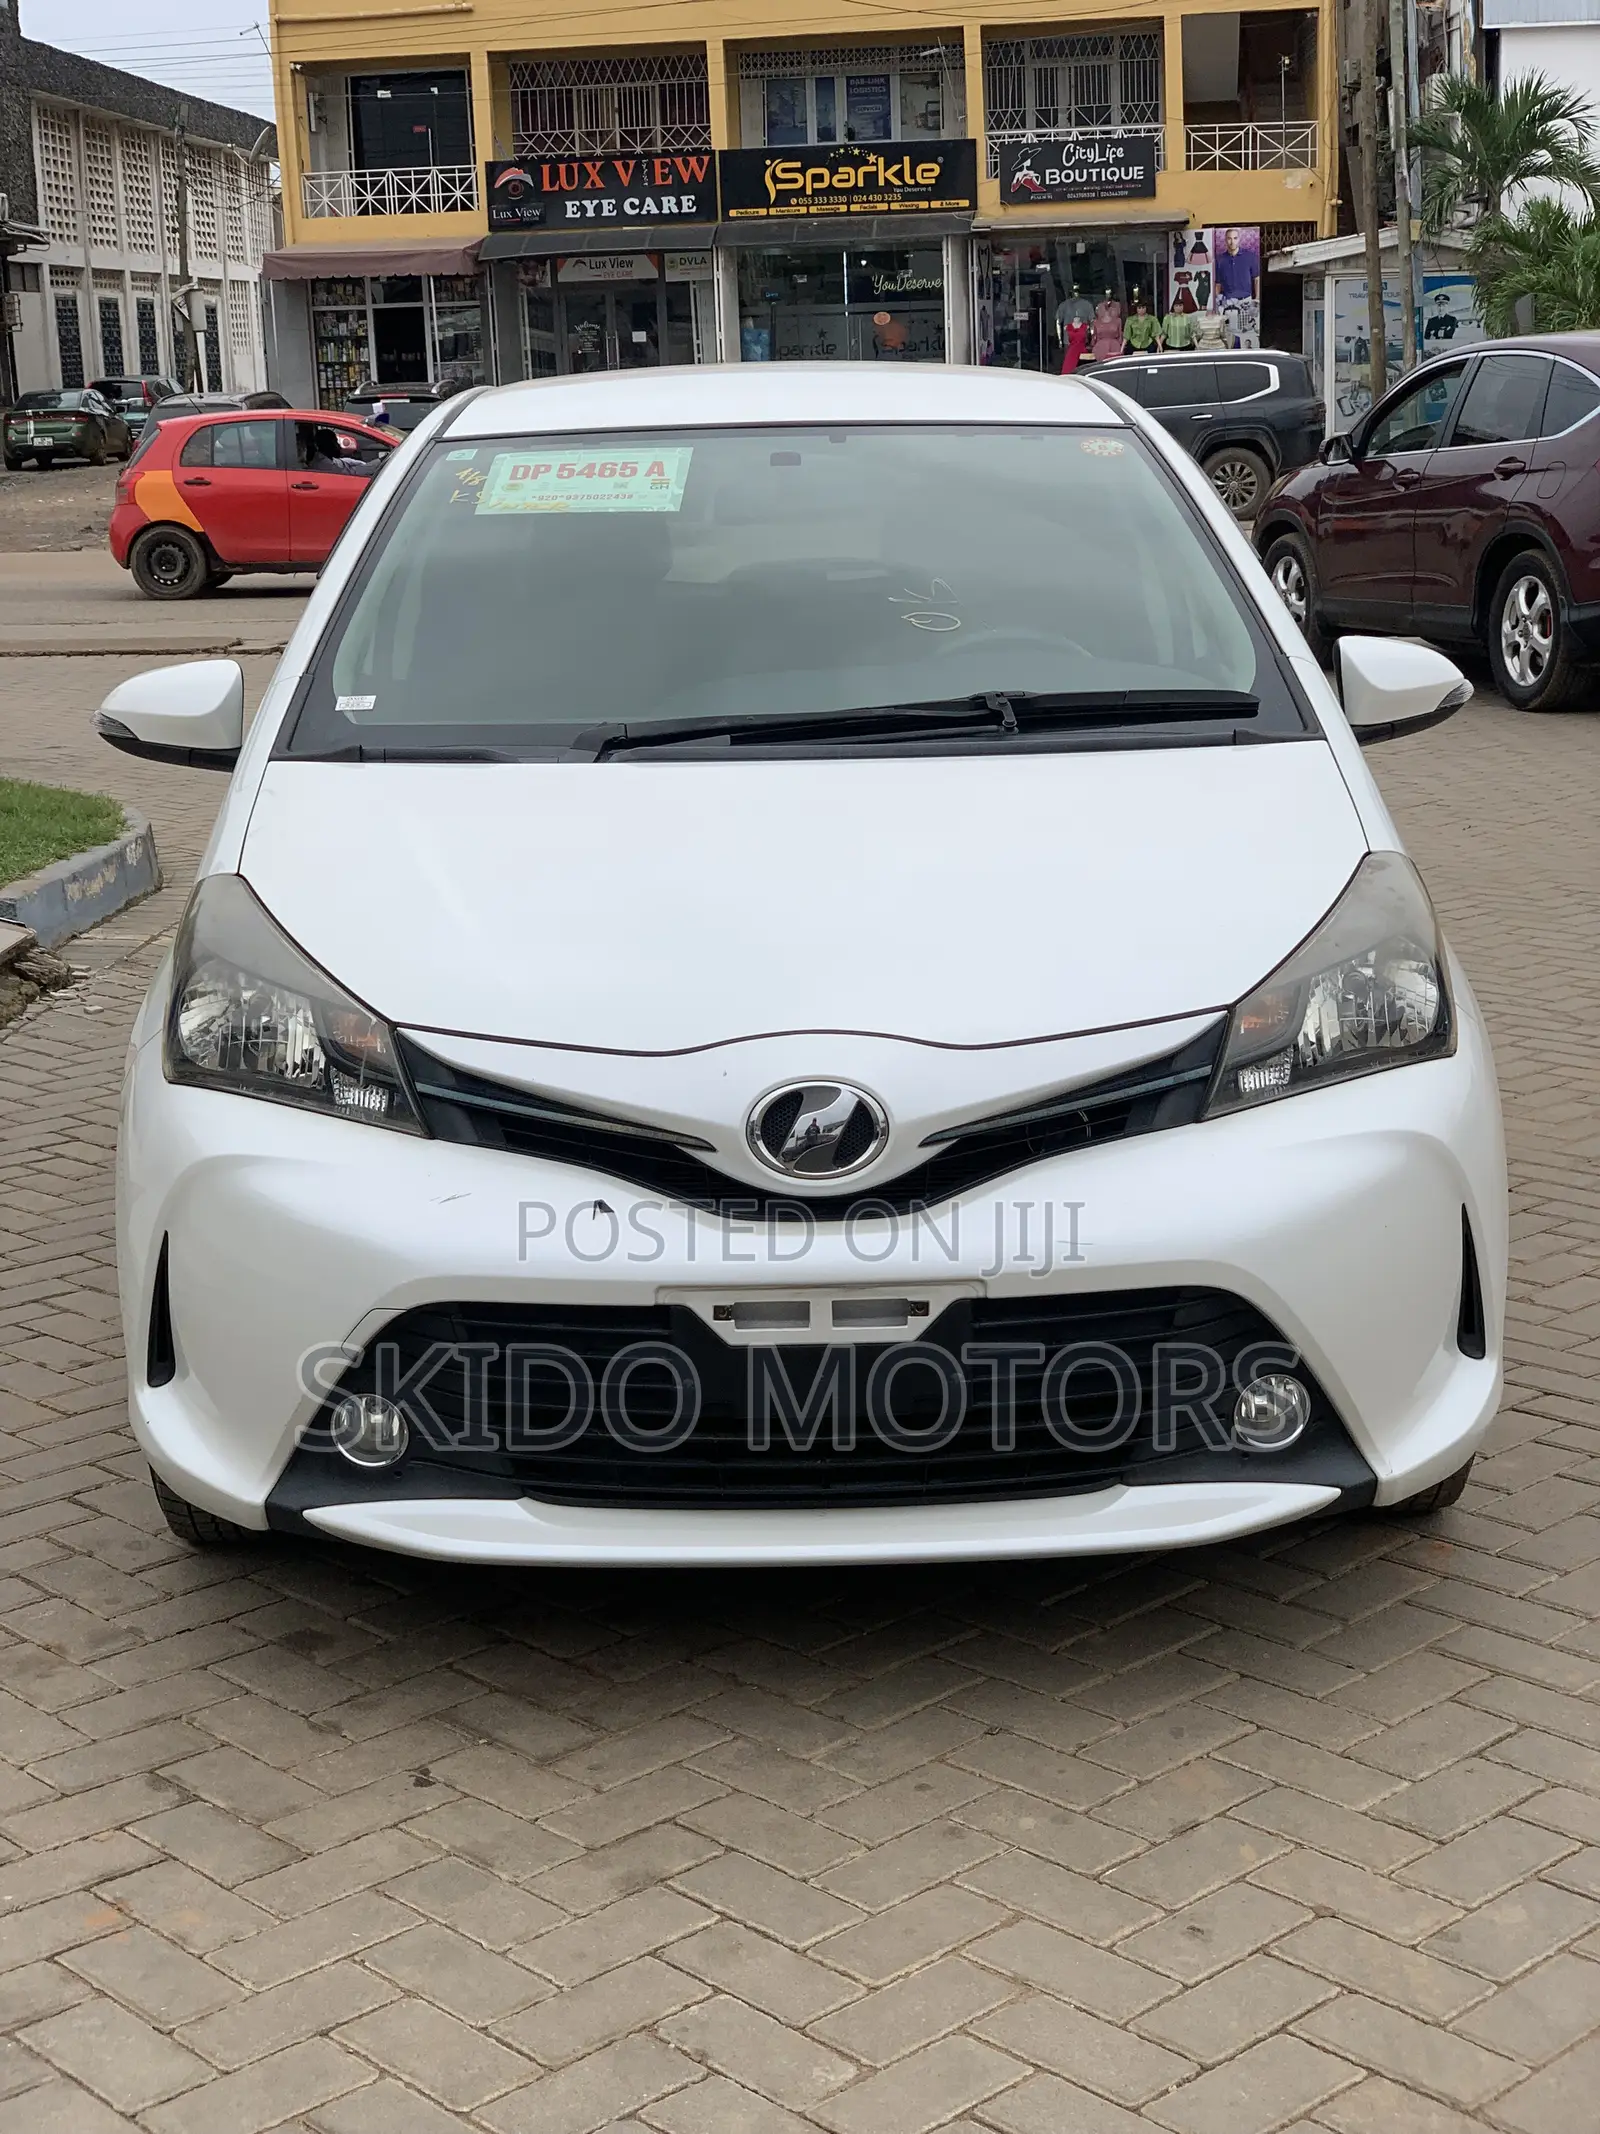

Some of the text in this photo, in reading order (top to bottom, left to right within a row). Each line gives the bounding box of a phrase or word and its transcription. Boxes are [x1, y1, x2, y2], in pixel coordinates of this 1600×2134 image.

[1062, 143, 1125, 167] CityLife
[540, 161, 605, 192] LUX
[1045, 166, 1144, 185] BOUTIQUE
[565, 194, 697, 218] EYE CARE
[829, 195, 847, 203] 3330
[853, 194, 867, 202] 024
[492, 207, 542, 219] Lux View
[589, 256, 634, 270] Lux View
[679, 257, 707, 266] DVLA
[871, 274, 942, 295] You Deserve
[509, 461, 665, 481] DP 5465 A
